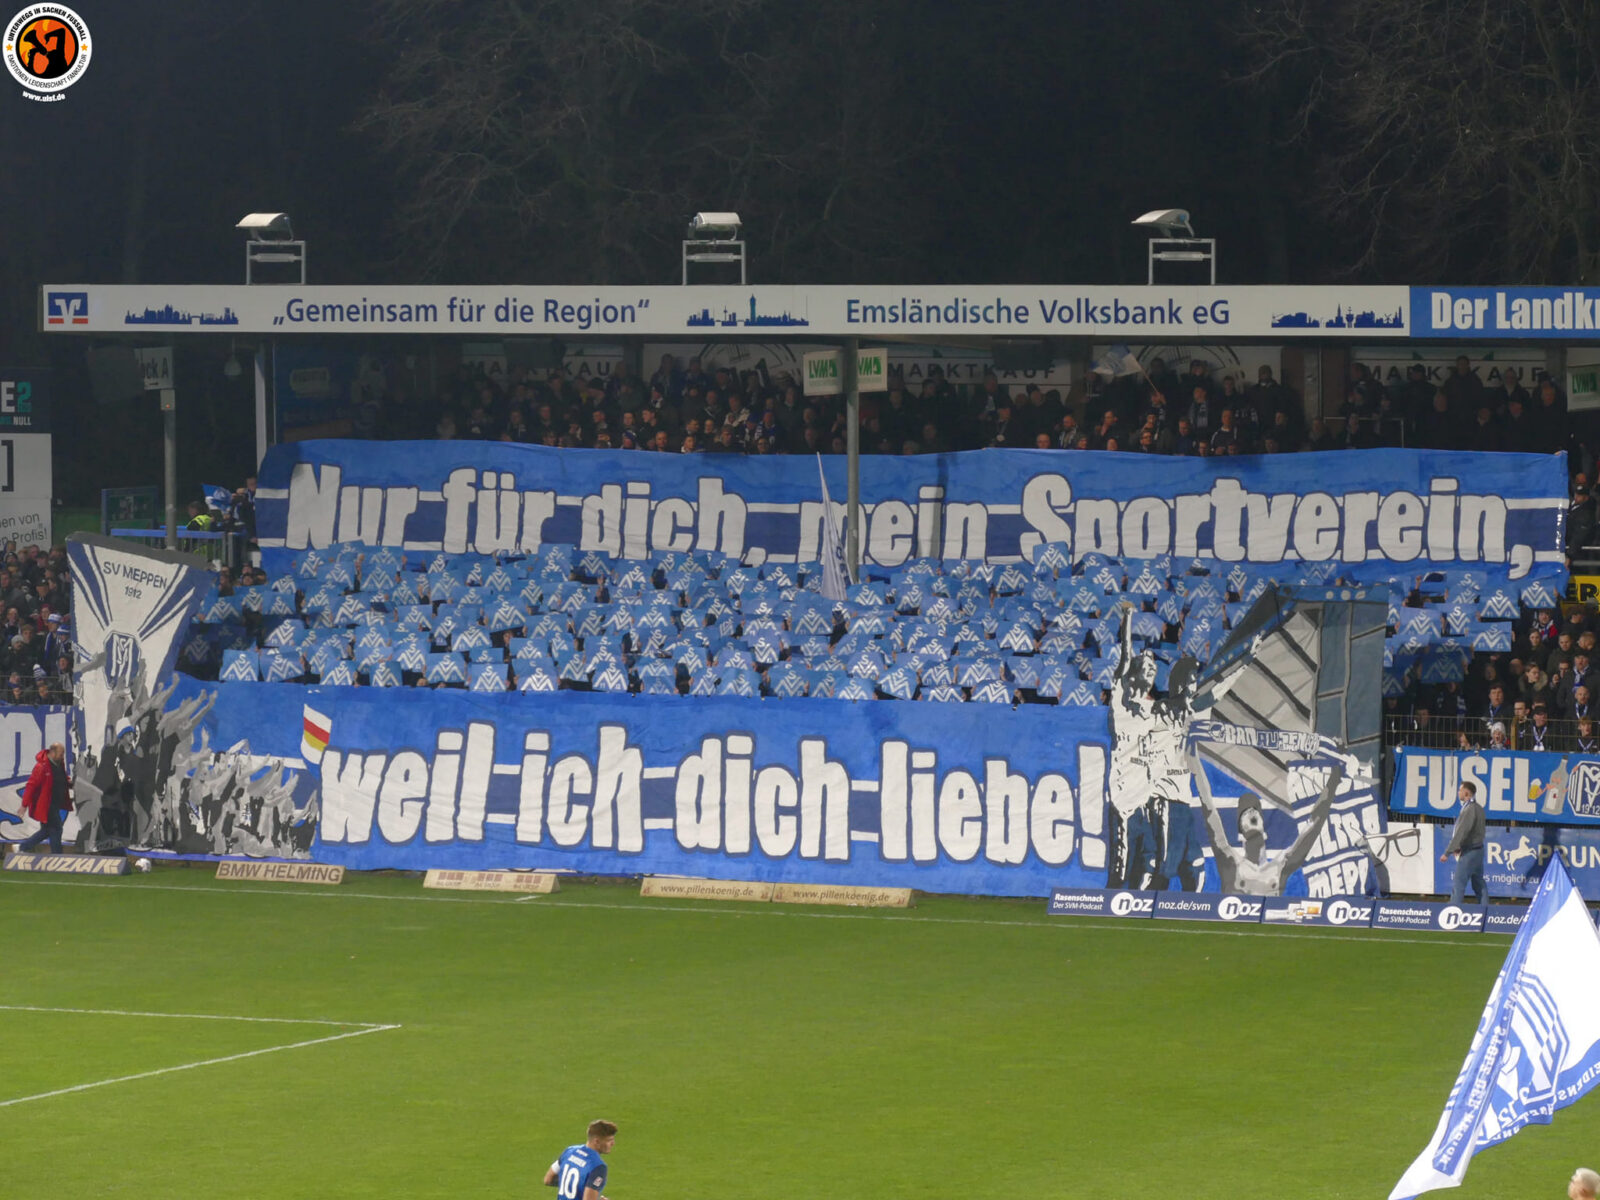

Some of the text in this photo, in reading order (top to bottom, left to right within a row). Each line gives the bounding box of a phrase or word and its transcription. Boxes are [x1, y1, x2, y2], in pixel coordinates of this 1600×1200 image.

[447, 297, 486, 323] für
[494, 298, 535, 323] die
[847, 298, 1231, 325] Emsländische Volksbank eG
[1431, 292, 1488, 330] Der
[18, 513, 40, 525] von
[285, 463, 418, 549] Nur
[442, 467, 555, 555] für
[799, 485, 989, 567] mein
[1019, 472, 1535, 580] Sportverein,
[11, 528, 48, 543] Profis!
[103, 561, 168, 589] SV MEPPEN
[124, 585, 142, 600] 1912
[1404, 754, 1537, 814] FUSEL
[320, 721, 1107, 868] weil ich dich liebe!
[36, 855, 97, 872] KUZKA
[218, 863, 342, 882] BMW HELMING
[1492, 871, 1527, 886] möglich
[660, 884, 754, 898] www.pillenkoenig.de
[792, 889, 890, 903] www.pillenkoenig.de
[1054, 893, 1105, 903] Rasenschnack
[1053, 901, 1103, 911] Der SVM-Podcast
[1114, 893, 1153, 914] noz
[1158, 900, 1211, 912] noz.de/svm
[1222, 898, 1262, 918] noz
[1331, 902, 1372, 922] noz
[1379, 906, 1432, 917] Rasenschnack
[1378, 915, 1430, 925] Der SVM-Podcast
[1442, 908, 1483, 928] noz
[1488, 914, 1523, 926] noz.de/
[558, 1163, 580, 1200] 10
